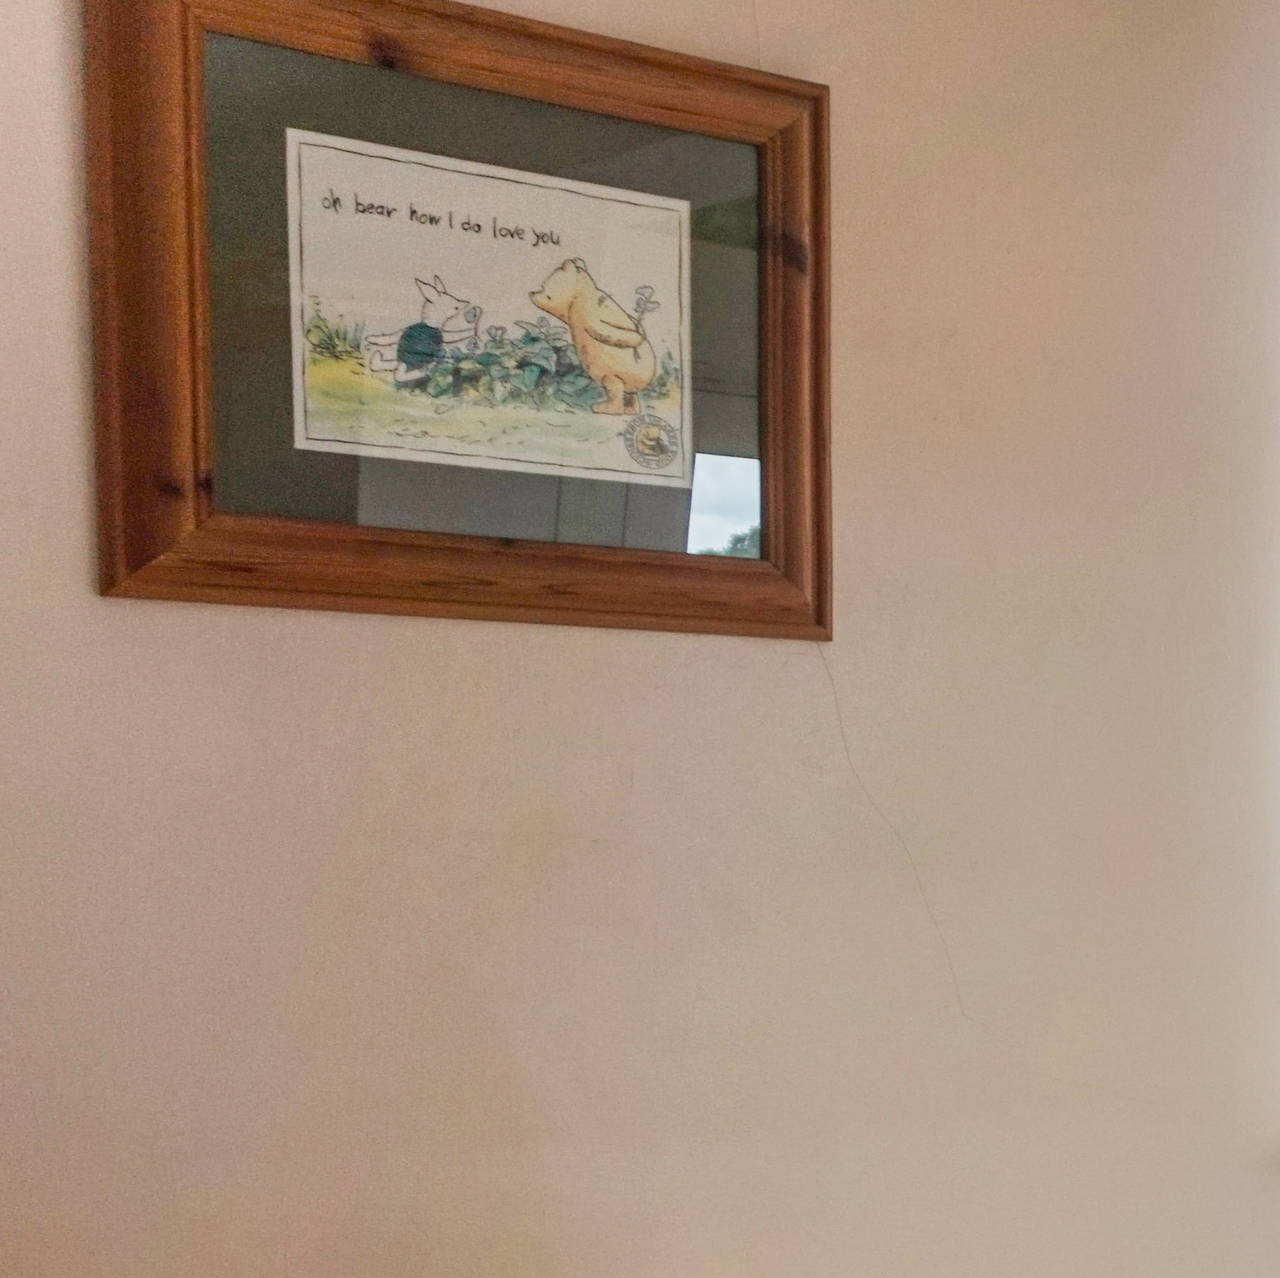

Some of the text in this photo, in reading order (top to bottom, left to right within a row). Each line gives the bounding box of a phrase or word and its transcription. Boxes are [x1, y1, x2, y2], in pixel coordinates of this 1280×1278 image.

[321, 188, 561, 248] oh bear how I do love you
